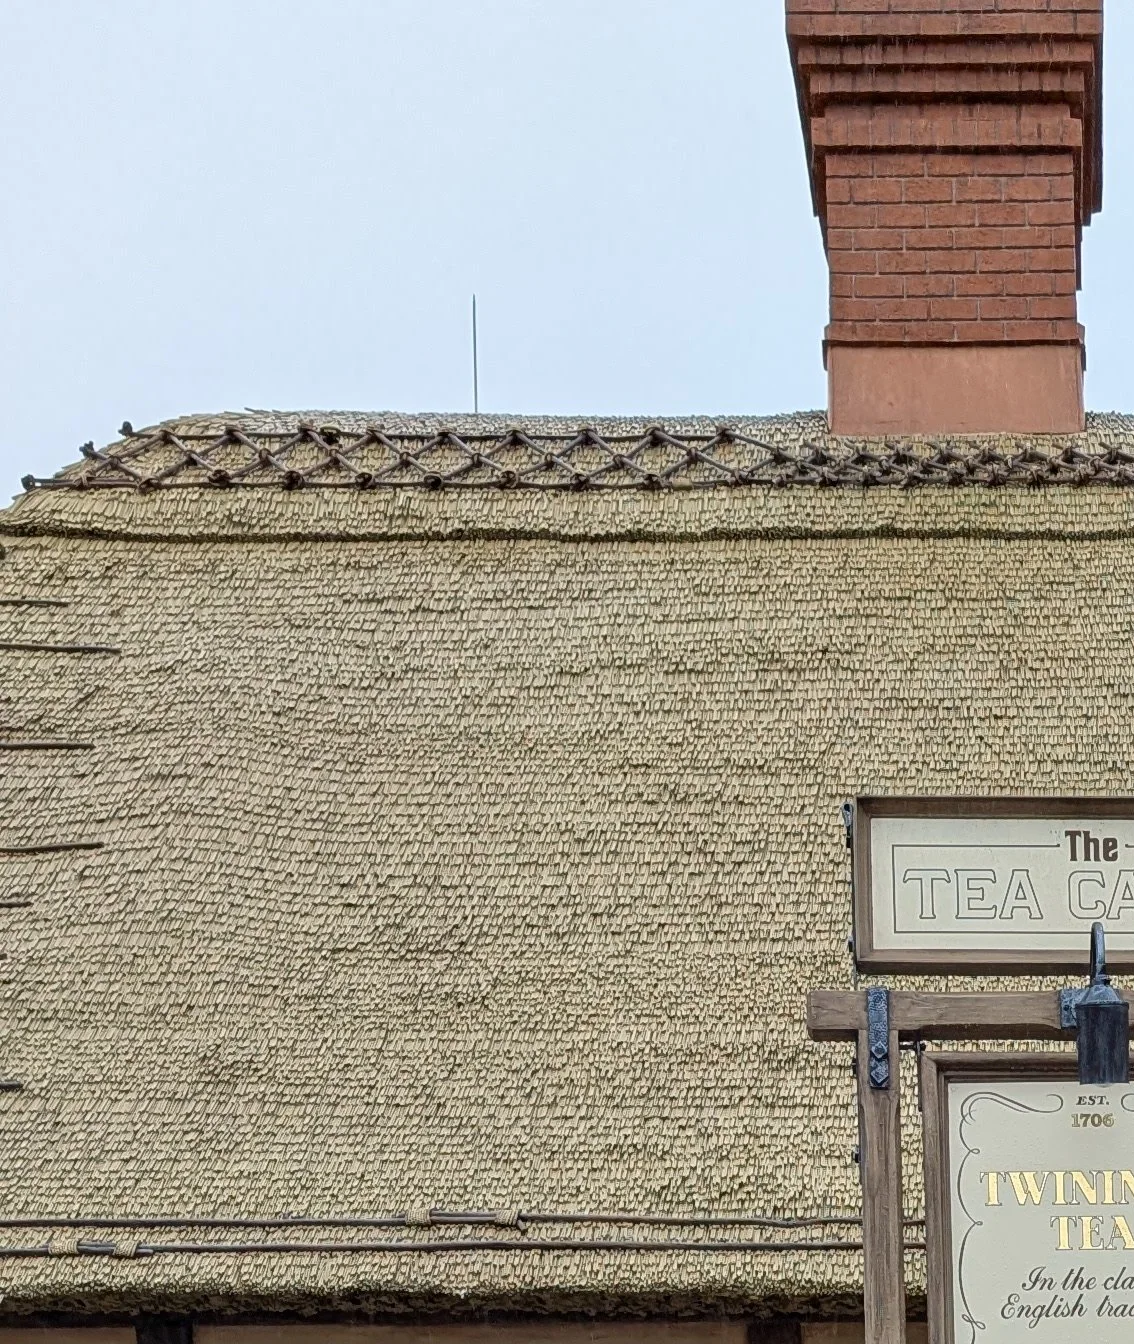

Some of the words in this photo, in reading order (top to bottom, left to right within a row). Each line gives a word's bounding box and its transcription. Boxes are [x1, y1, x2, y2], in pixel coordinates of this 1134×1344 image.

[1064, 828, 1119, 863] The
[902, 868, 1044, 921] TEA
[1075, 1094, 1110, 1106] EST.
[1071, 1112, 1115, 1128] 1706
[1022, 1266, 1056, 1291] In
[1060, 1266, 1097, 1291] the
[1001, 1293, 1087, 1329] English
